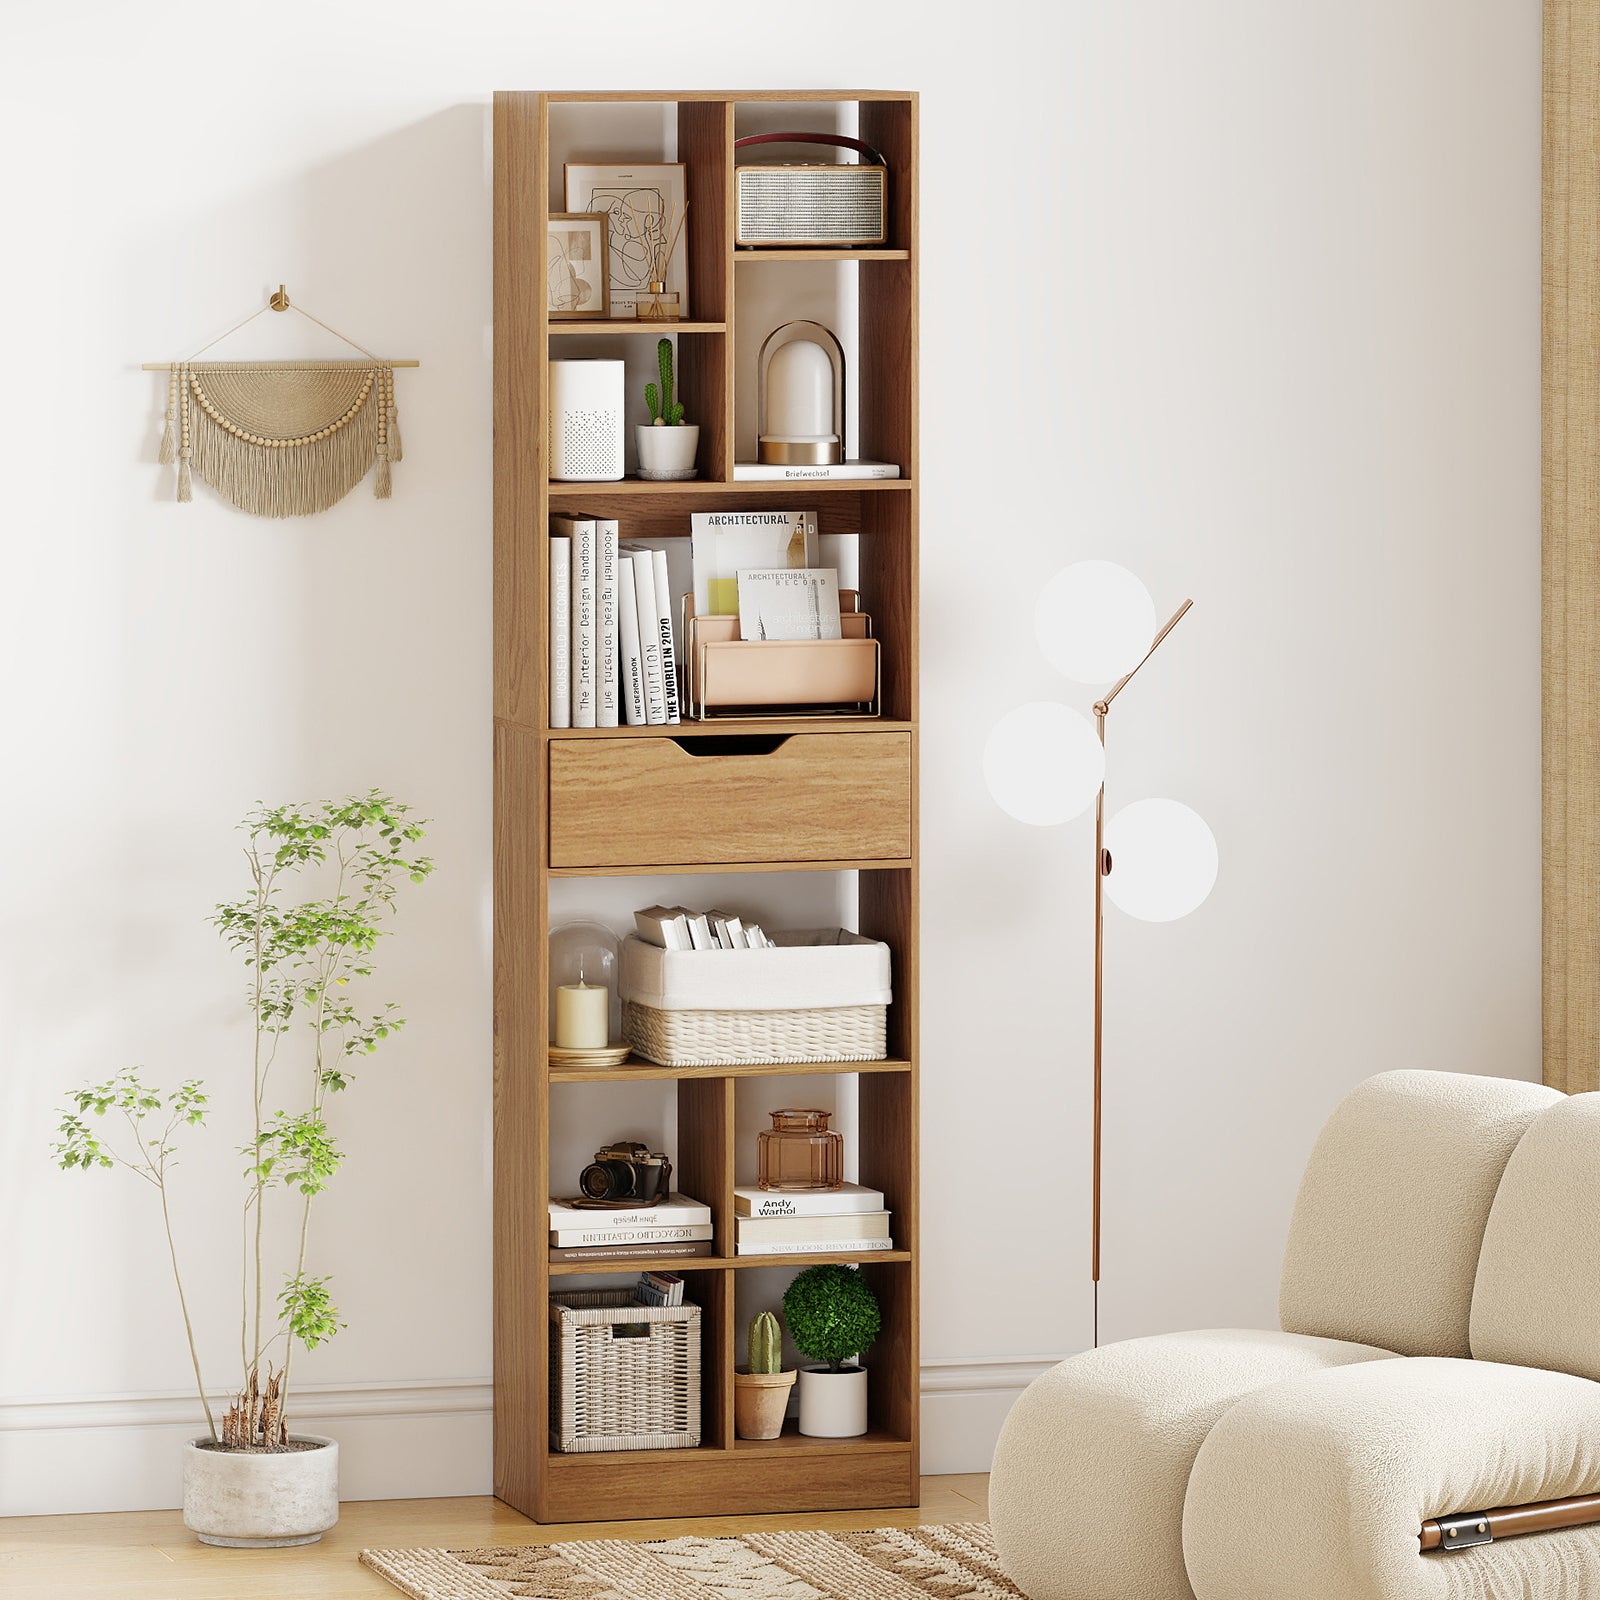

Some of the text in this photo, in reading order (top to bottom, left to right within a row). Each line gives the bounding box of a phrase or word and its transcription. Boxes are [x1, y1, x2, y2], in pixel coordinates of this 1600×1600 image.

[708, 515, 789, 525] ARCHITECTURAL
[748, 573, 807, 581] ARCHITECTURAL
[580, 529, 592, 710] The Interior Design Handbook
[557, 634, 566, 698] HOUSEHOLD
[660, 618, 678, 720] THE WORLD IN 2020
[646, 644, 663, 720] INTUITION
[763, 1199, 792, 1208] Andy
[758, 1207, 796, 1216] Warhol
[826, 1242, 889, 1251] REVOLUTION
